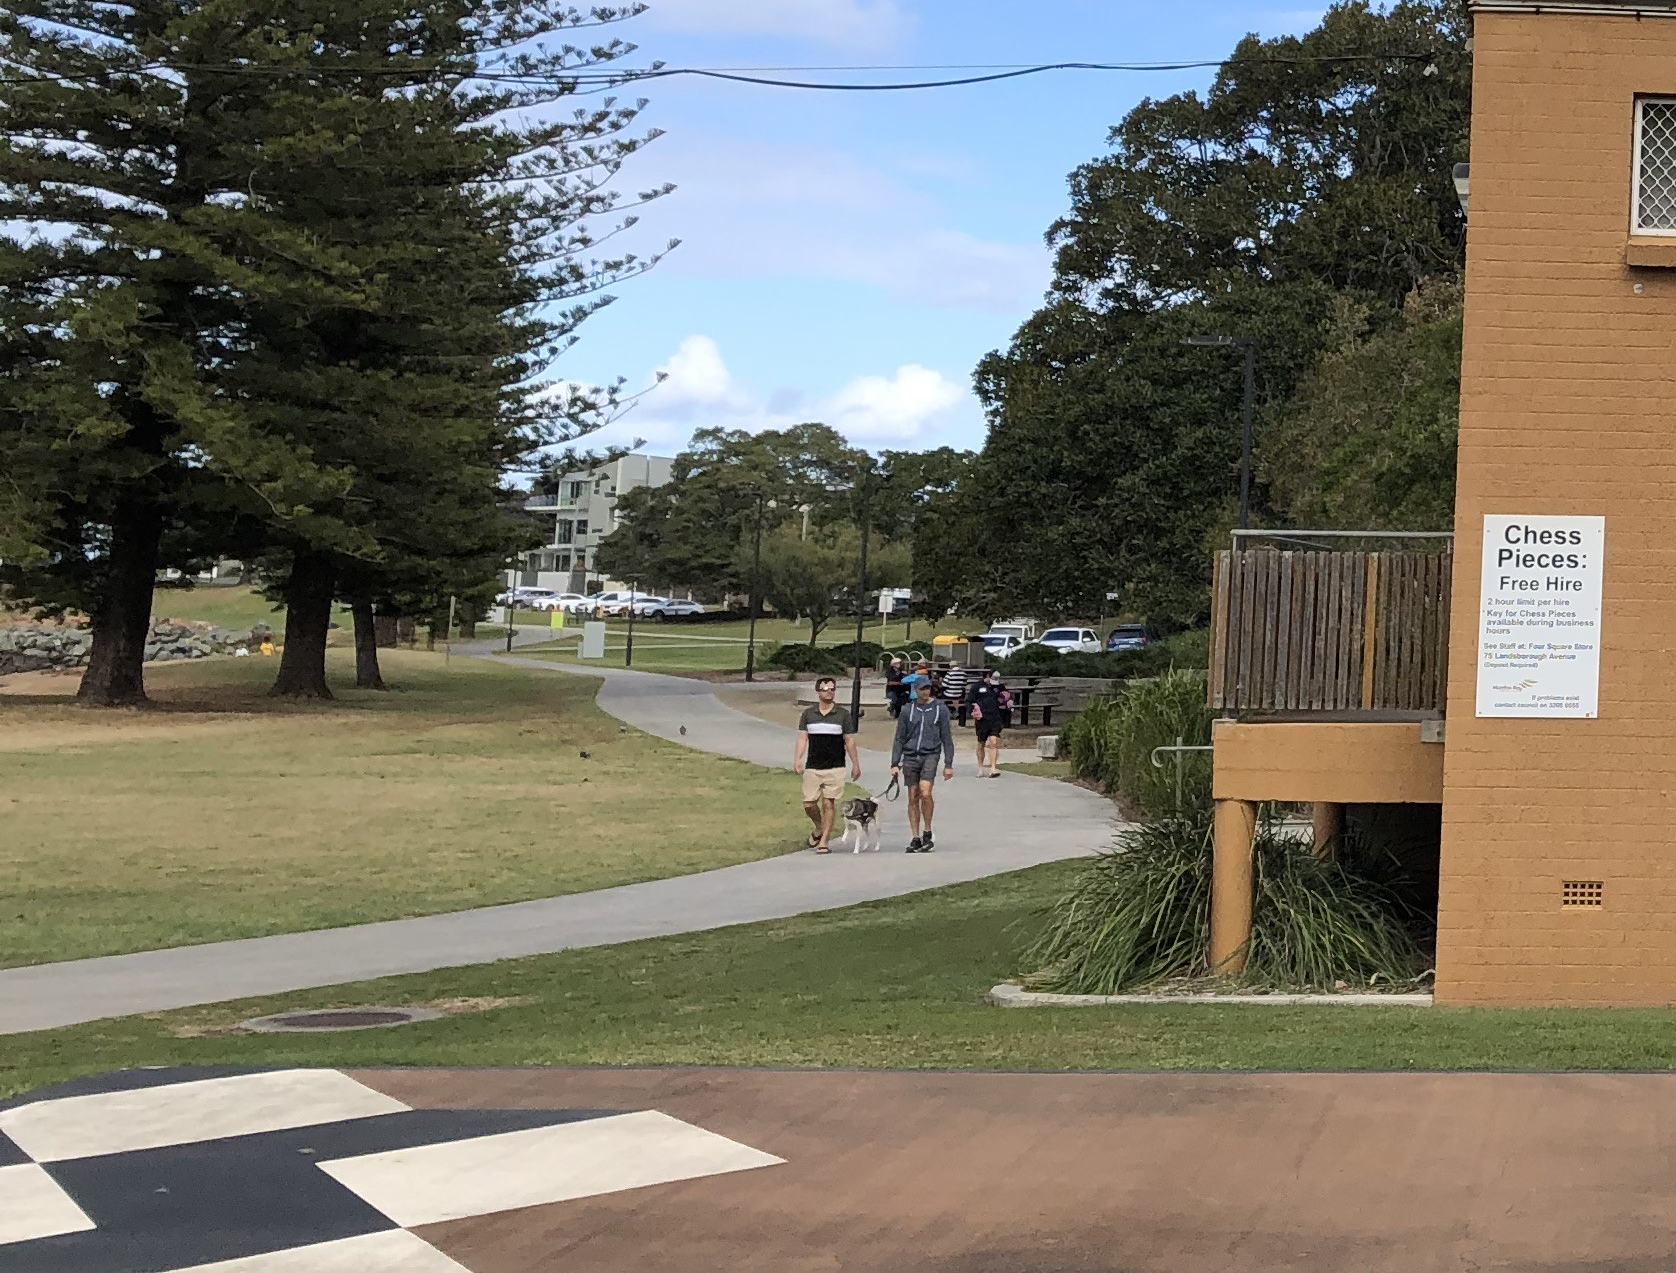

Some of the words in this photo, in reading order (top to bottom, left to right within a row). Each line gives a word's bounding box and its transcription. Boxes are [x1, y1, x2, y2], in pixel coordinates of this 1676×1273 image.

[1505, 524, 1582, 545] Chess
[1498, 548, 1586, 569] Pieces:
[1500, 576, 1540, 591] Free
[1547, 576, 1582, 591] Hire
[1488, 597, 1493, 605] 2
[1538, 599, 1550, 607] per
[1554, 598, 1570, 606] hire
[1487, 609, 1502, 618] Key
[1506, 609, 1518, 617] for
[1520, 609, 1546, 618] Chess
[1549, 609, 1576, 618] Pieces
[1527, 619, 1554, 628] during
[1486, 627, 1510, 635] hours
[1484, 642, 1498, 650] See
[1500, 642, 1516, 650] Staff
[1547, 643, 1572, 651] Square
[1495, 652, 1548, 661] Landsborough
[1549, 652, 1576, 660] Avenue
